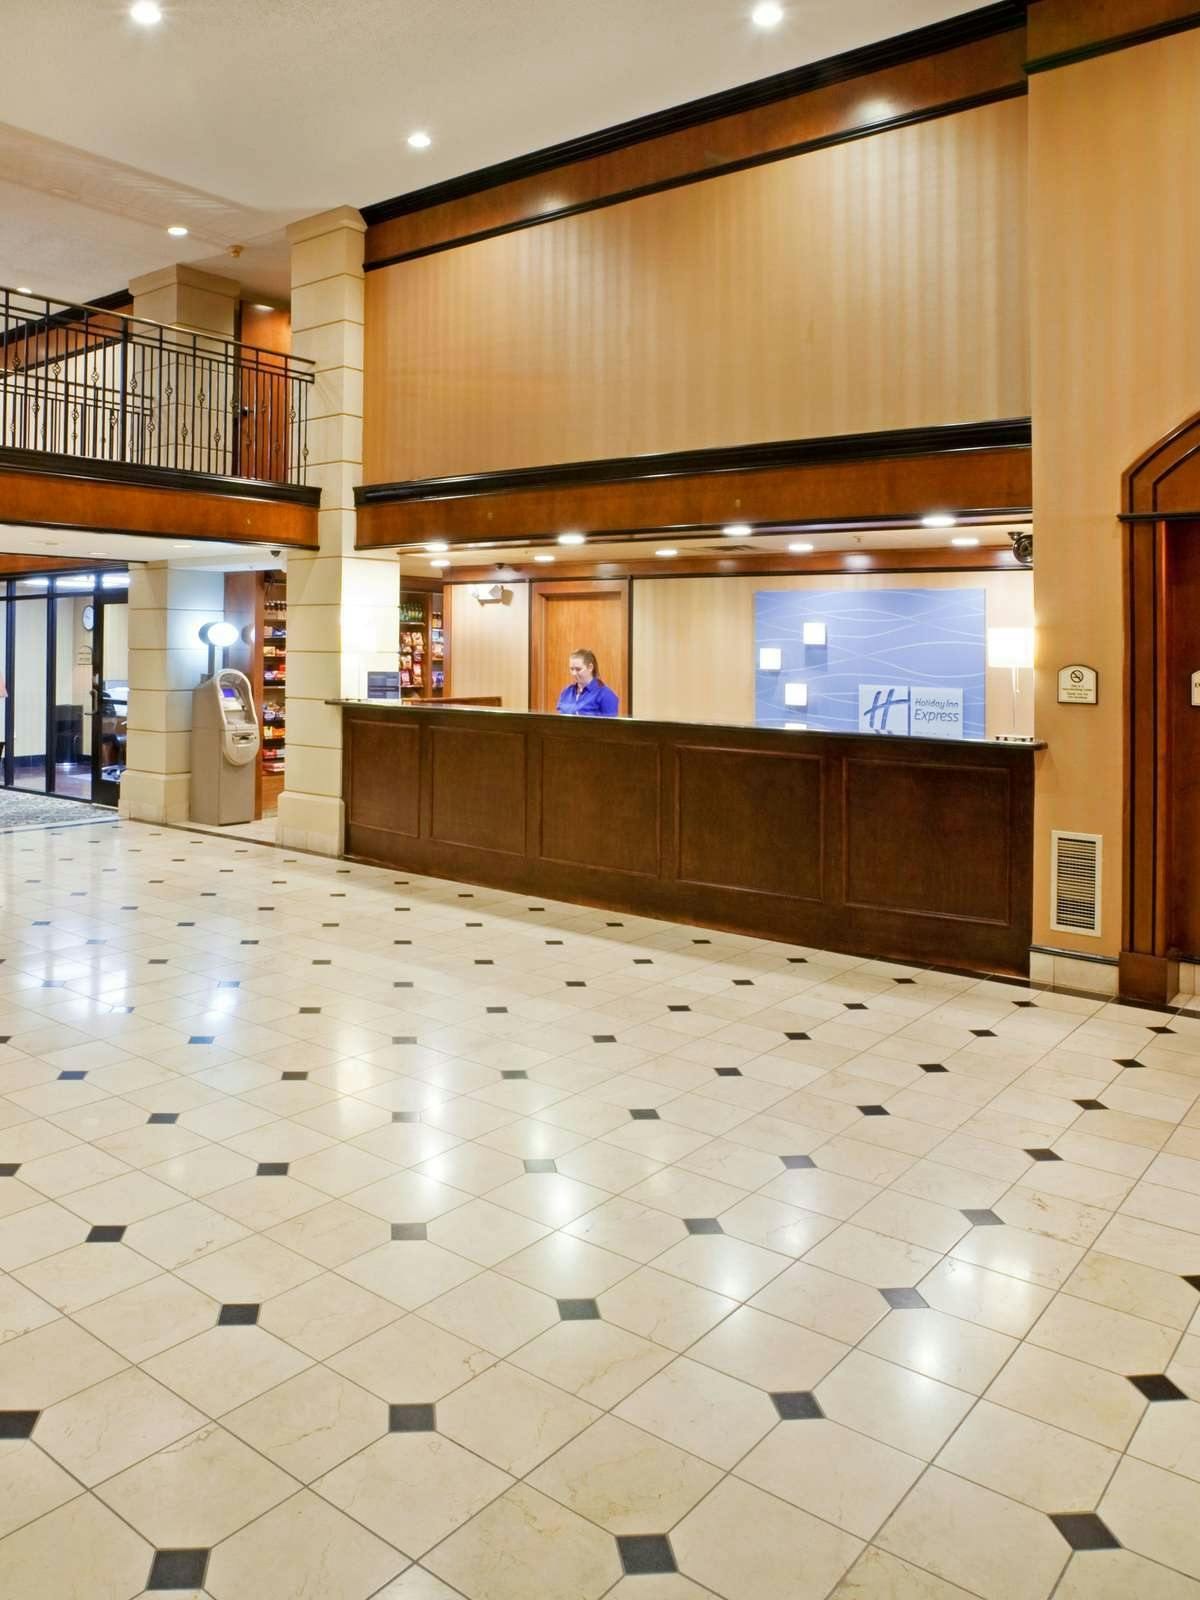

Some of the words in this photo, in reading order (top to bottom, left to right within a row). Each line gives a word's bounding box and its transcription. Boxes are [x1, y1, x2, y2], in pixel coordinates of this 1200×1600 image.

[914, 698, 945, 709] Holiday
[946, 700, 959, 708] Inn
[914, 708, 959, 724] Express
